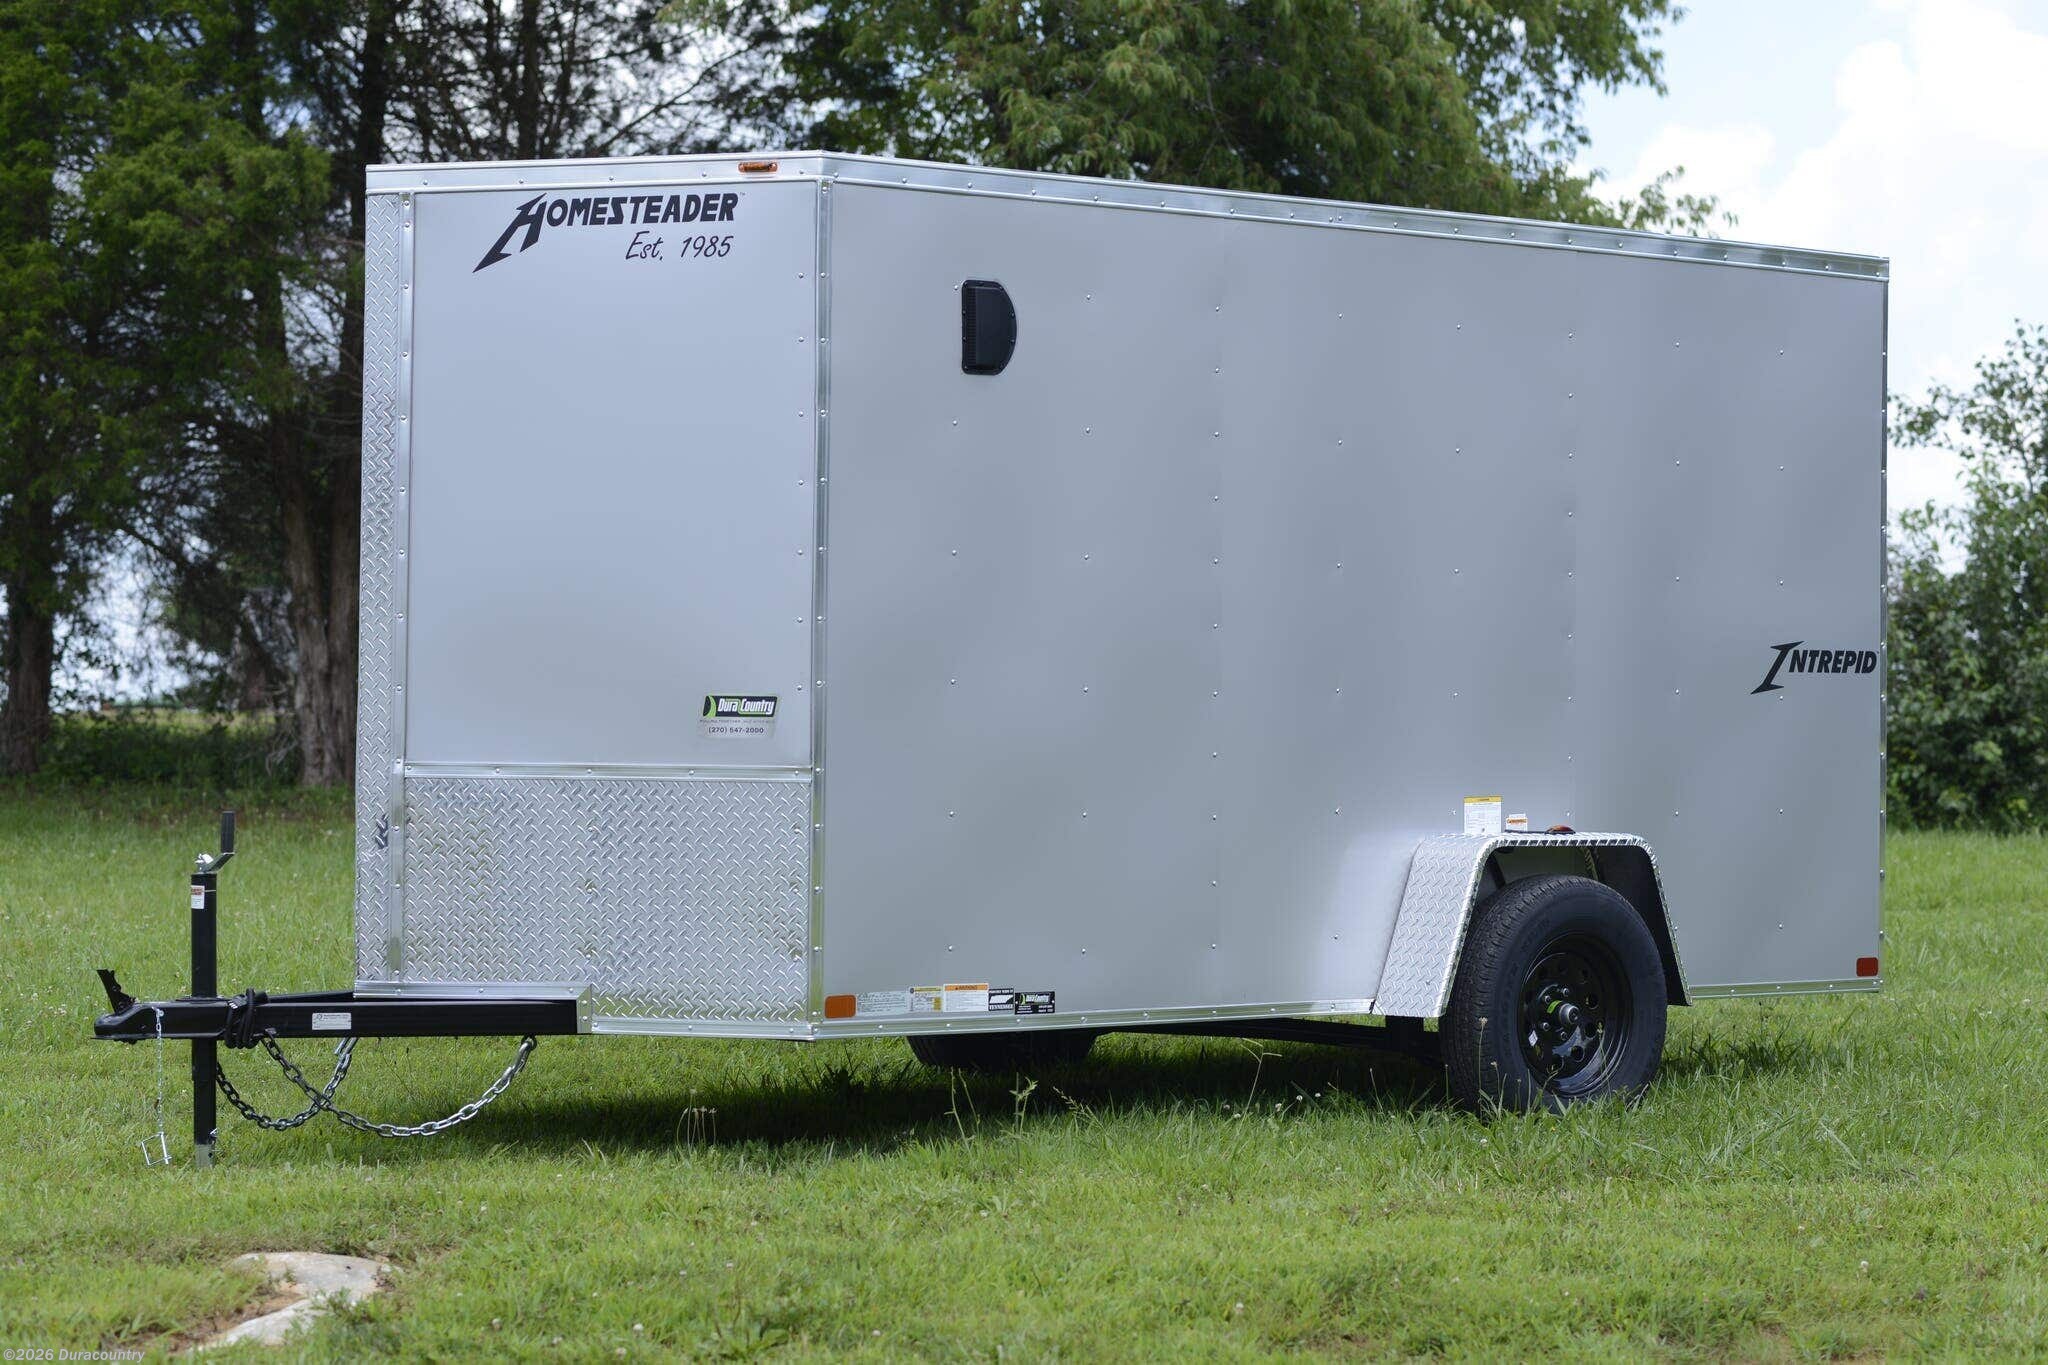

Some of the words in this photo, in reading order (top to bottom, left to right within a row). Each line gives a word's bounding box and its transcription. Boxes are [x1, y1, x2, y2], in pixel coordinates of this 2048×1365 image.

[472, 193, 739, 273] HOMESTEADER
[680, 235, 734, 258] 1985
[1750, 641, 1877, 695] INTREPID
[717, 698, 738, 712] Dura
[740, 698, 775, 715] Country
[708, 726, 728, 734] (270)
